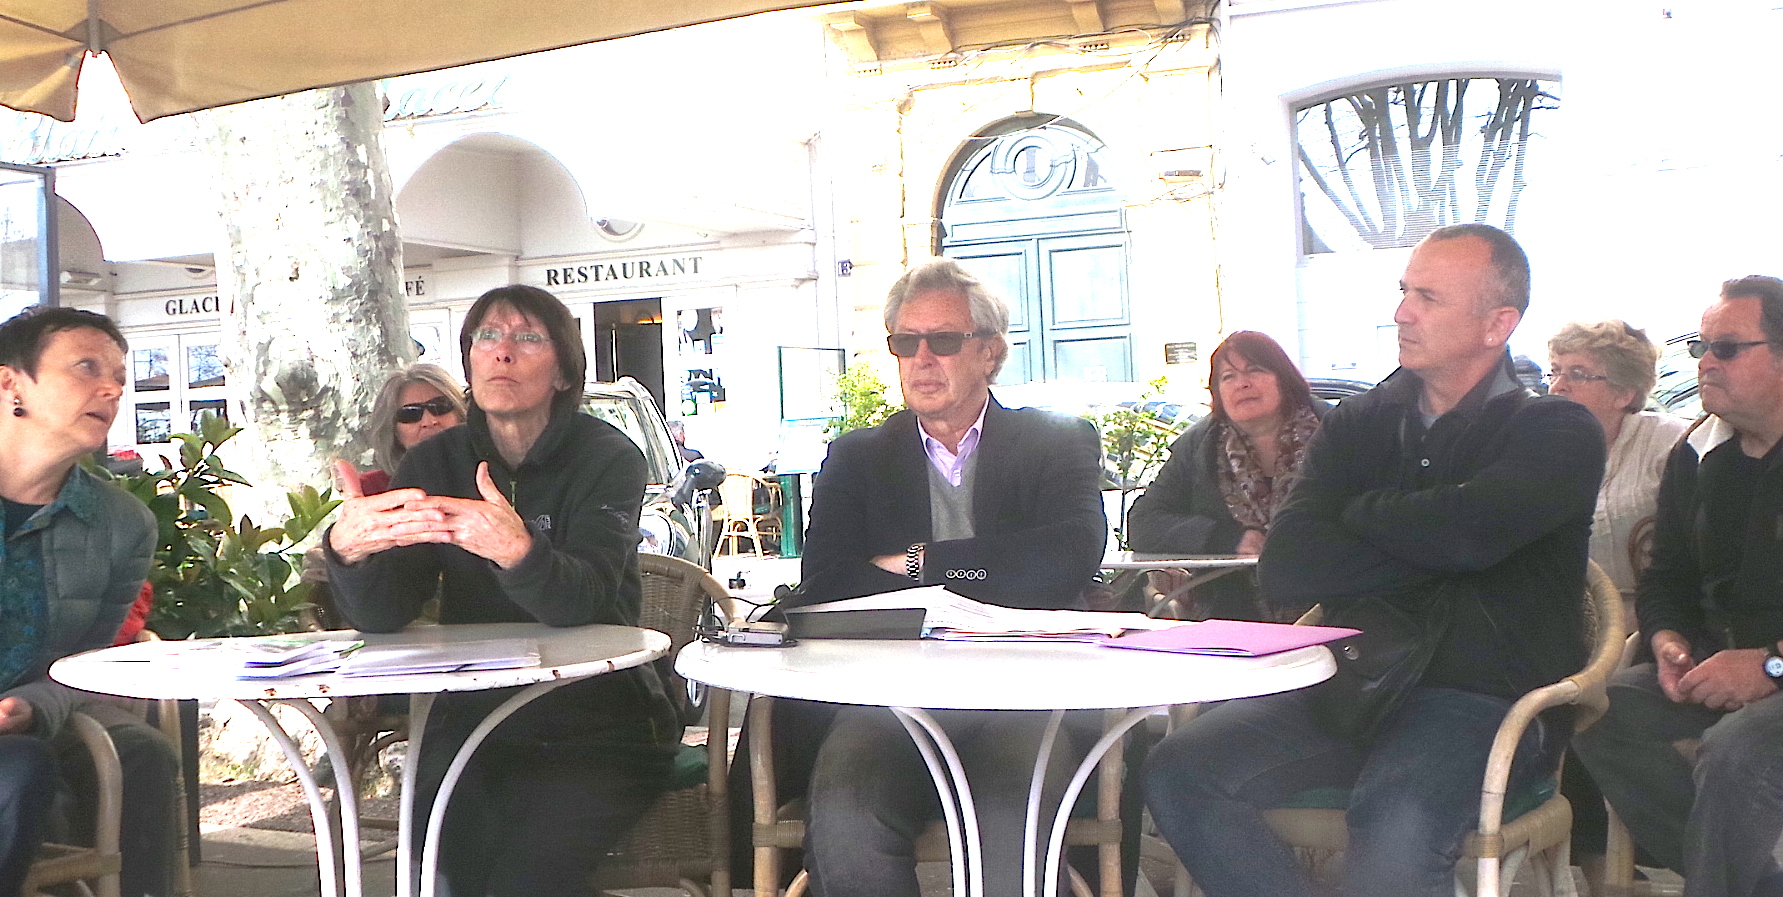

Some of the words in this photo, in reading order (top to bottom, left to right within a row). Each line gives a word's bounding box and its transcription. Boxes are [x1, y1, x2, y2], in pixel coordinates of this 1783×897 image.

[545, 256, 703, 286] RESTAURANT
[838, 262, 851, 275] 13
[405, 275, 425, 297] FÉ
[165, 295, 220, 316] GLACI
